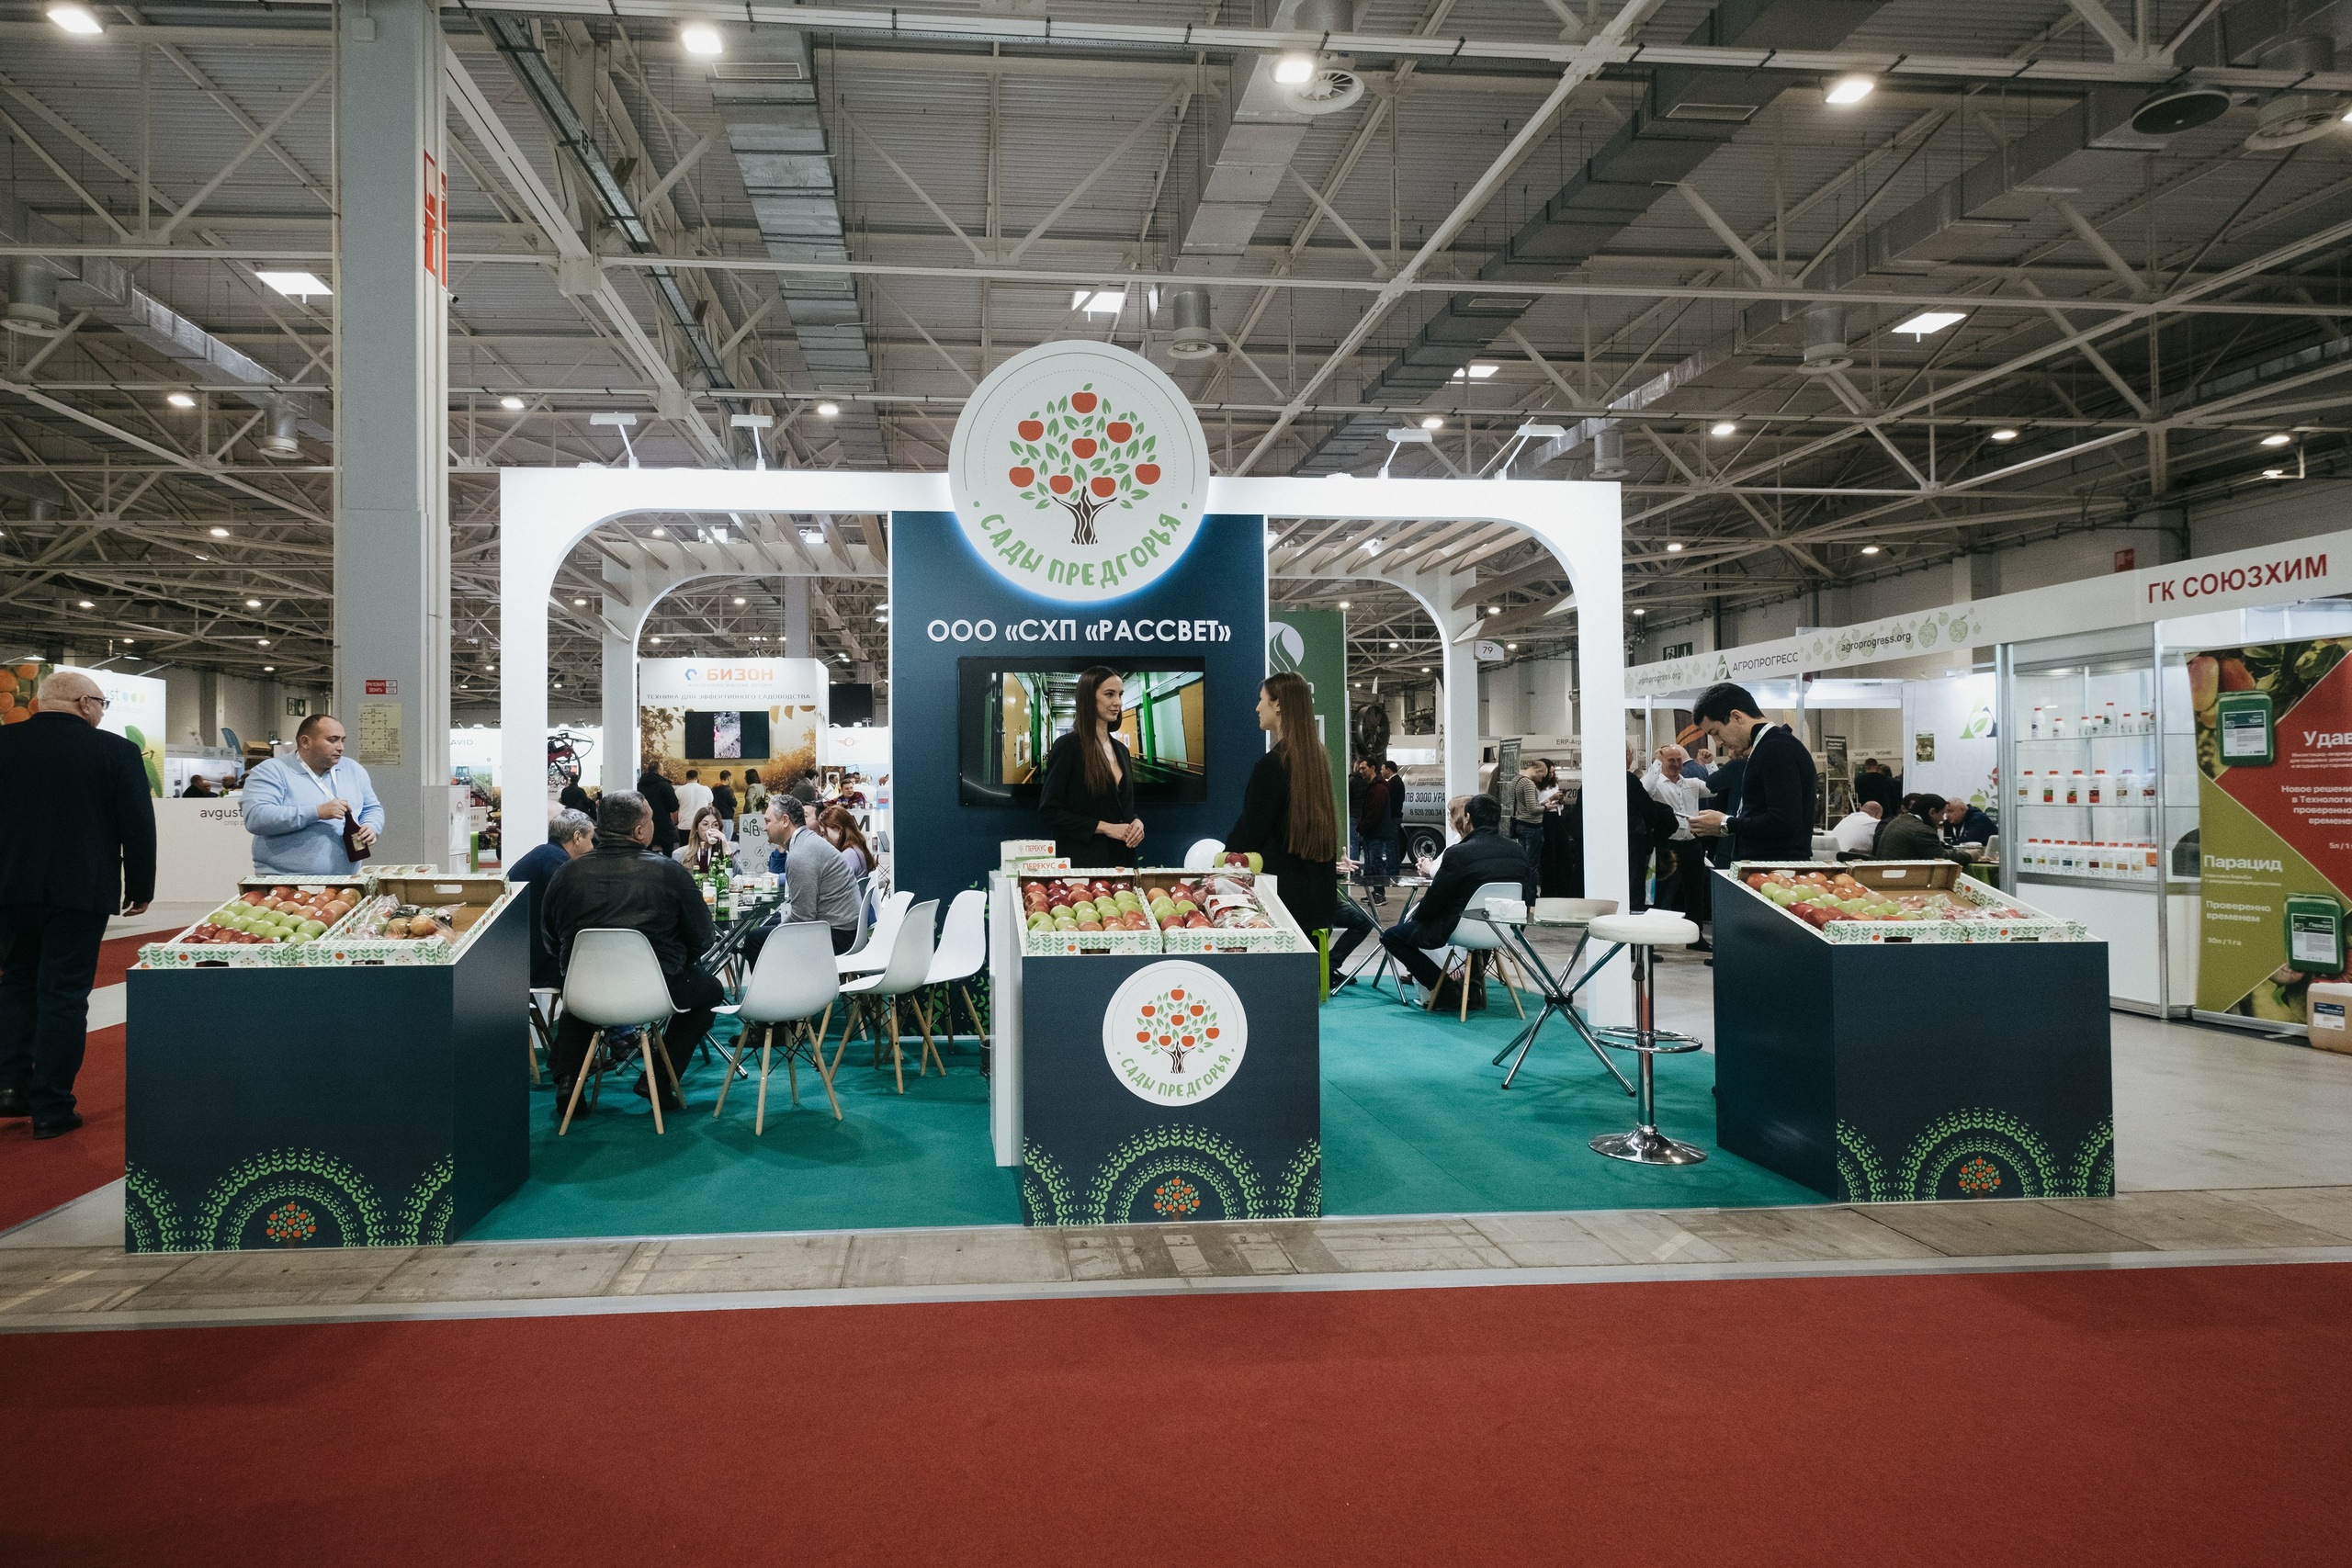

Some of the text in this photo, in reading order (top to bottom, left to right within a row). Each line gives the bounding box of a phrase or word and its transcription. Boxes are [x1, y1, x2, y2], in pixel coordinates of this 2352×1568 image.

[980, 513, 1182, 589] САДЫ ПРЕДГОРЬЯ
[2148, 554, 2327, 604] ГК СОЮЗХИМ
[927, 619, 1231, 642] ООО «СХП «РАССВЕТ»
[1840, 631, 1911, 653] agroprogress.org
[1482, 646, 1493, 654] 79
[1732, 651, 1799, 672] АГРОПРОГРЕСС
[707, 668, 774, 682] БИЗОН
[1637, 671, 1681, 685] agroprogress.org
[1415, 792, 1432, 803] 3000
[199, 808, 243, 820] avgust
[1025, 844, 1046, 852] ПЕРЕКУС
[2203, 854, 2283, 873] Парацид
[2206, 900, 2271, 912] Проверенно
[2206, 912, 2260, 922] временем
[1121, 1055, 1231, 1098] САДЫ ПРЕДГОРЬЯ
